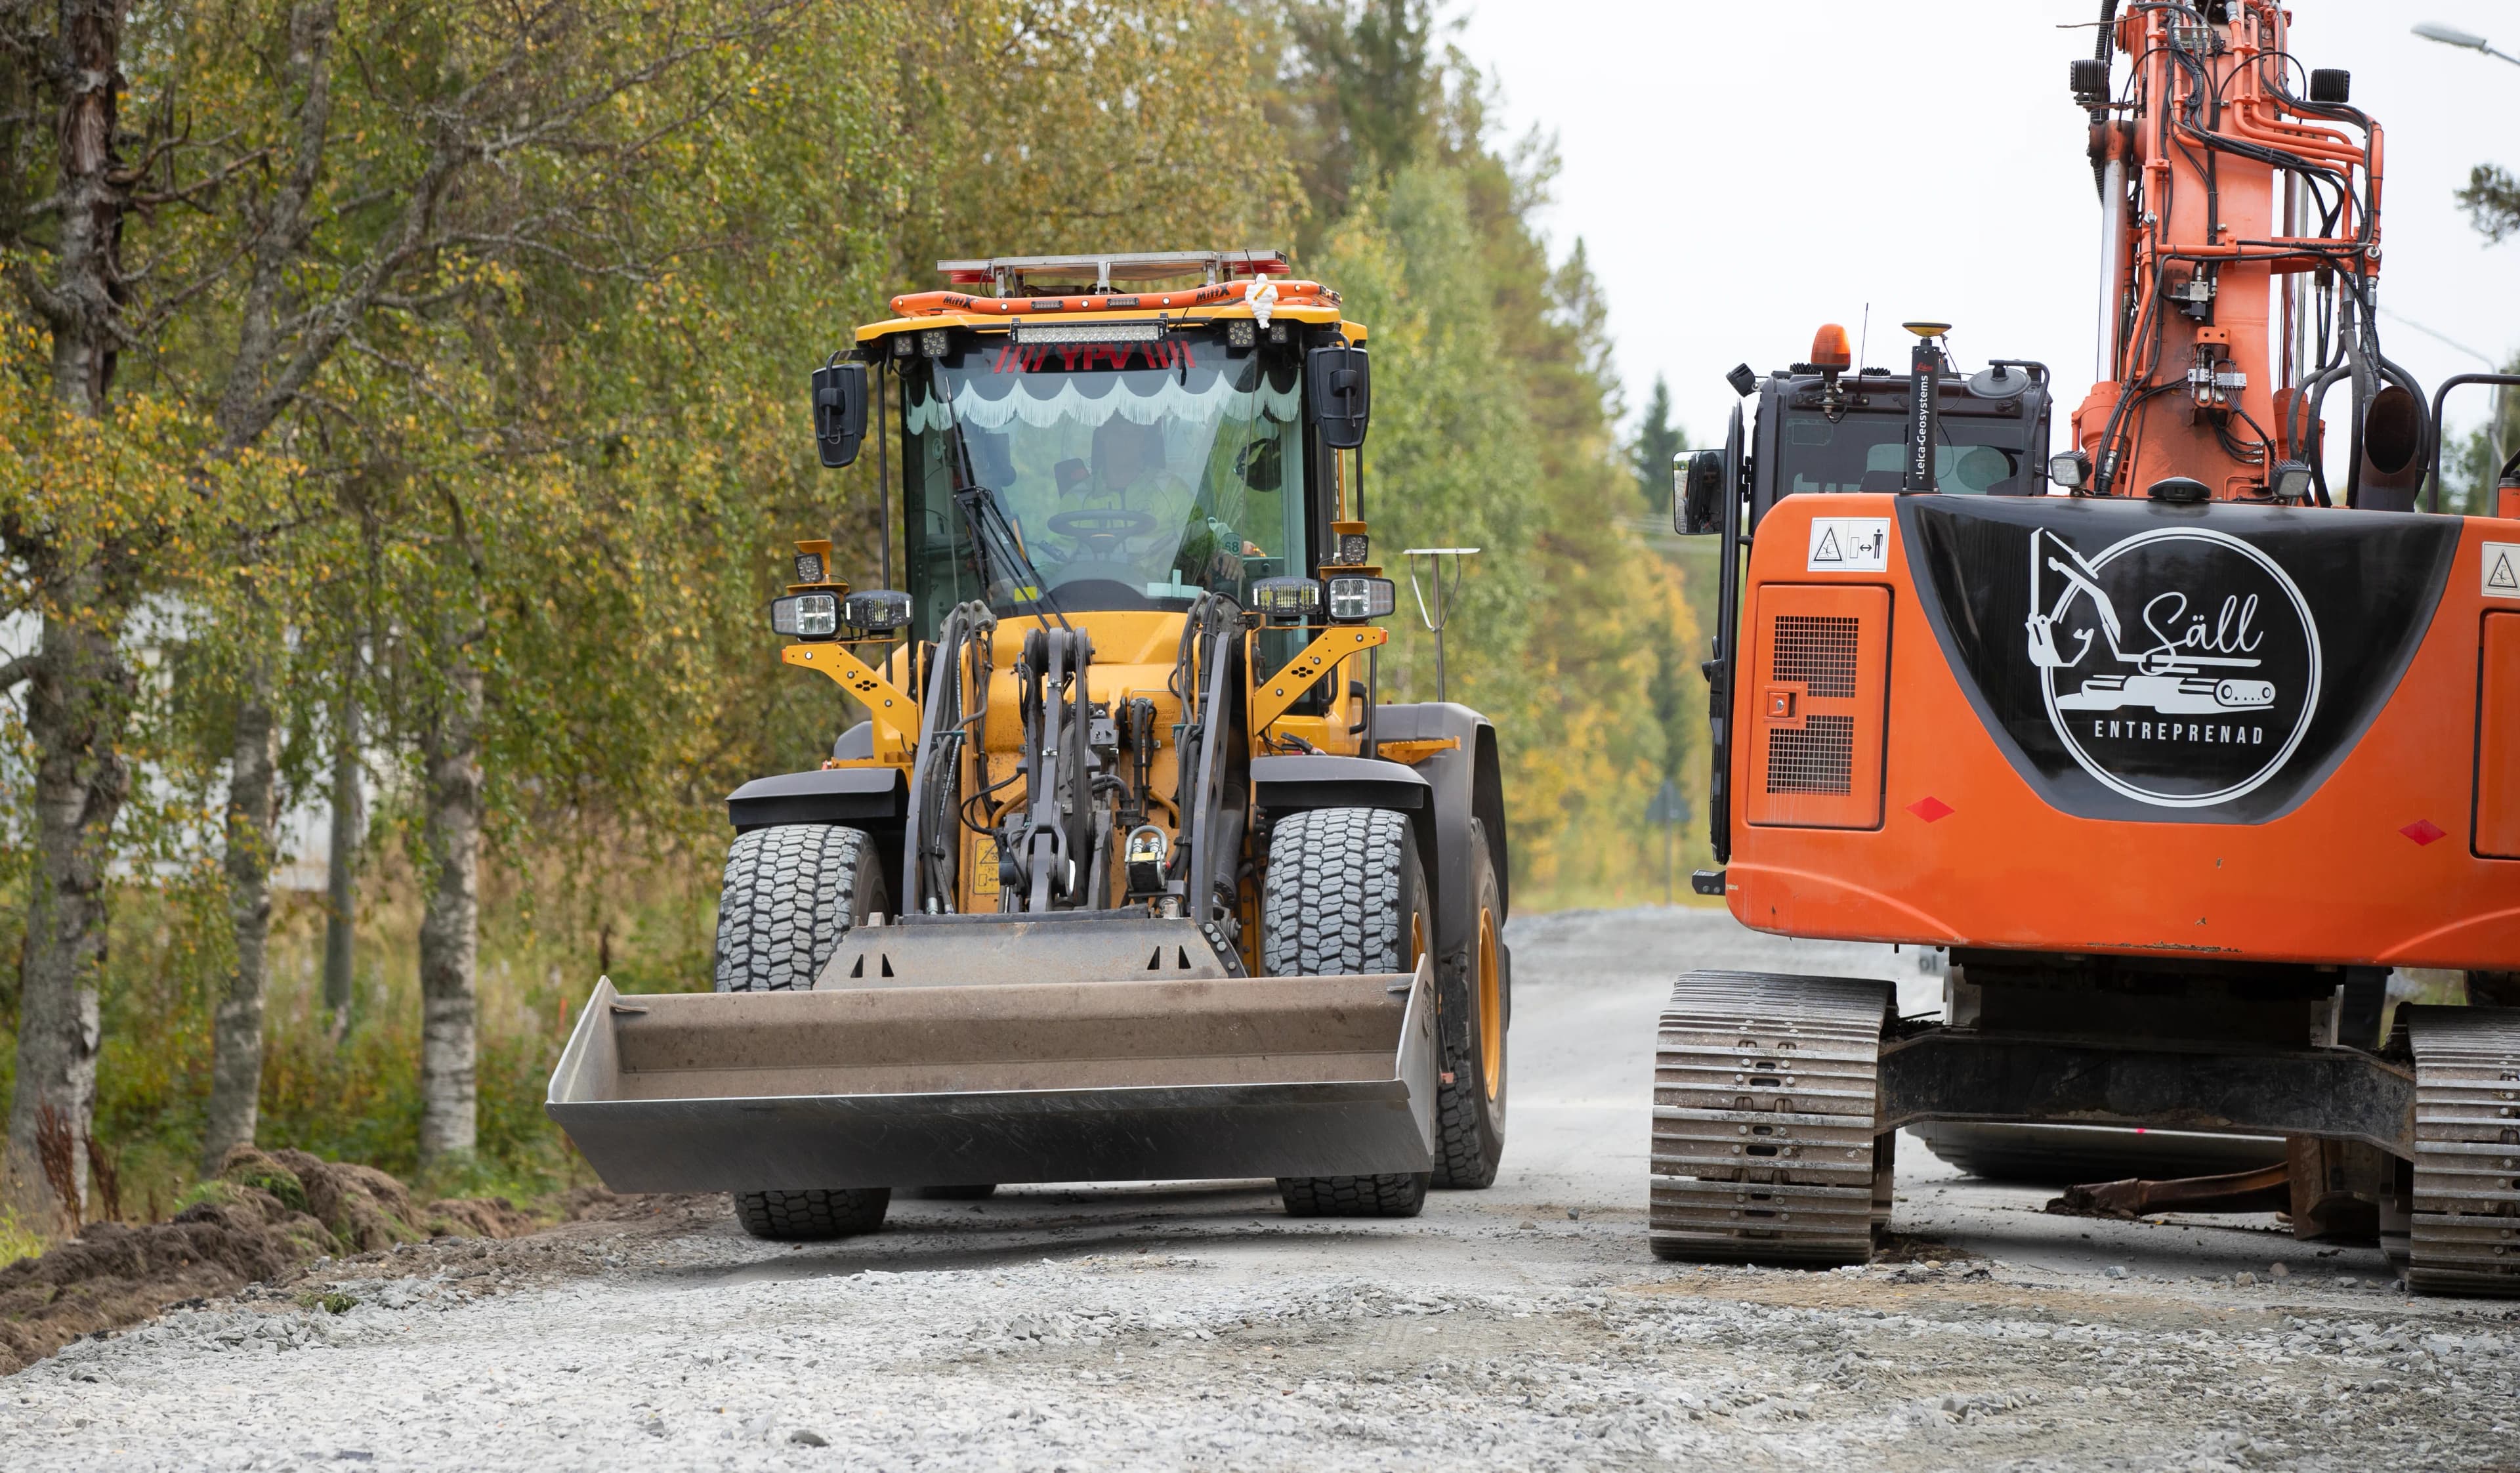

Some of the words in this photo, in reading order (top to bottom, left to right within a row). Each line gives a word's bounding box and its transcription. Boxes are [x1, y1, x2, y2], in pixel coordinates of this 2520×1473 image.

[1916, 375, 1930, 443] Geosystems
[1916, 446, 1926, 475] Leica
[2138, 591, 2264, 675] Säll
[2094, 719, 2263, 744] ENTREPRENAD
